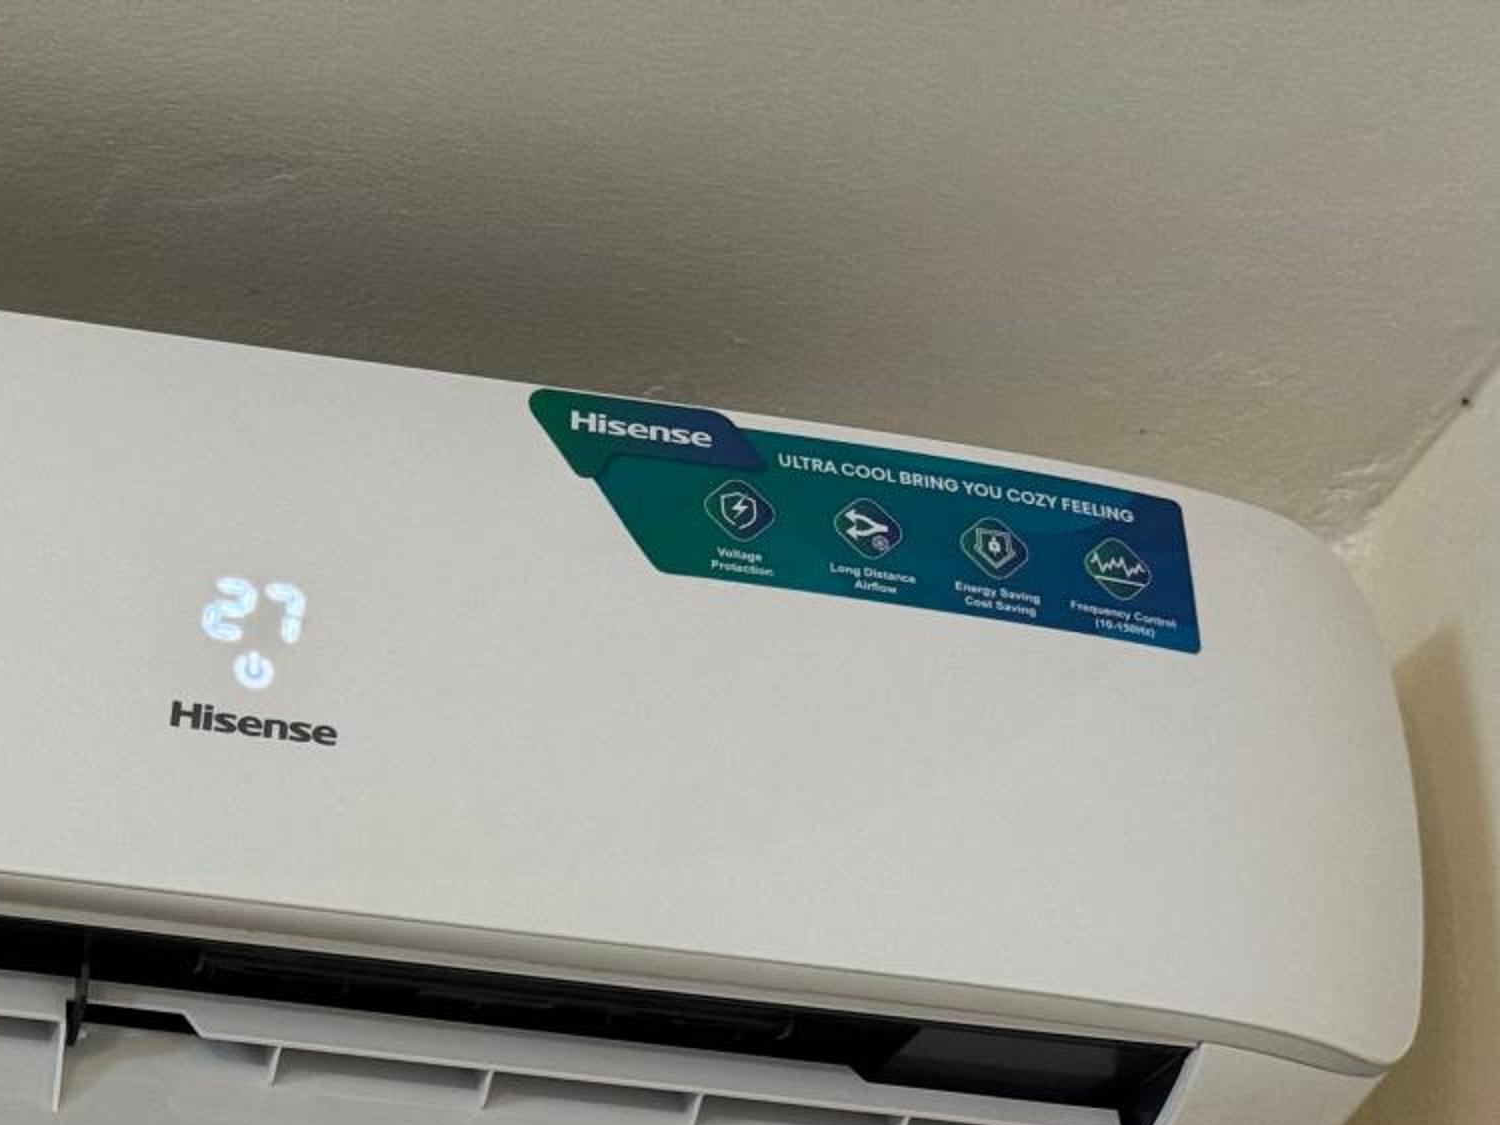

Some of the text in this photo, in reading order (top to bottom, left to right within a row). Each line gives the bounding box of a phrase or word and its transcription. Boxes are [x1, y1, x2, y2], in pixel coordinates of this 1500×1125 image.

[570, 409, 713, 448] Hisense
[778, 452, 1135, 523] ULTRA COOL BRING YOU COZY FEELING
[717, 546, 763, 563] Voltage
[711, 559, 774, 576] Protection
[829, 562, 917, 584] Long Distance
[854, 579, 898, 594] Airflow
[955, 580, 1041, 604] Energy Saving
[201, 576, 307, 644] 27
[965, 597, 1037, 618] Cost Saving
[1070, 600, 1178, 629] Frequency Control
[170, 700, 338, 746] Hisense
